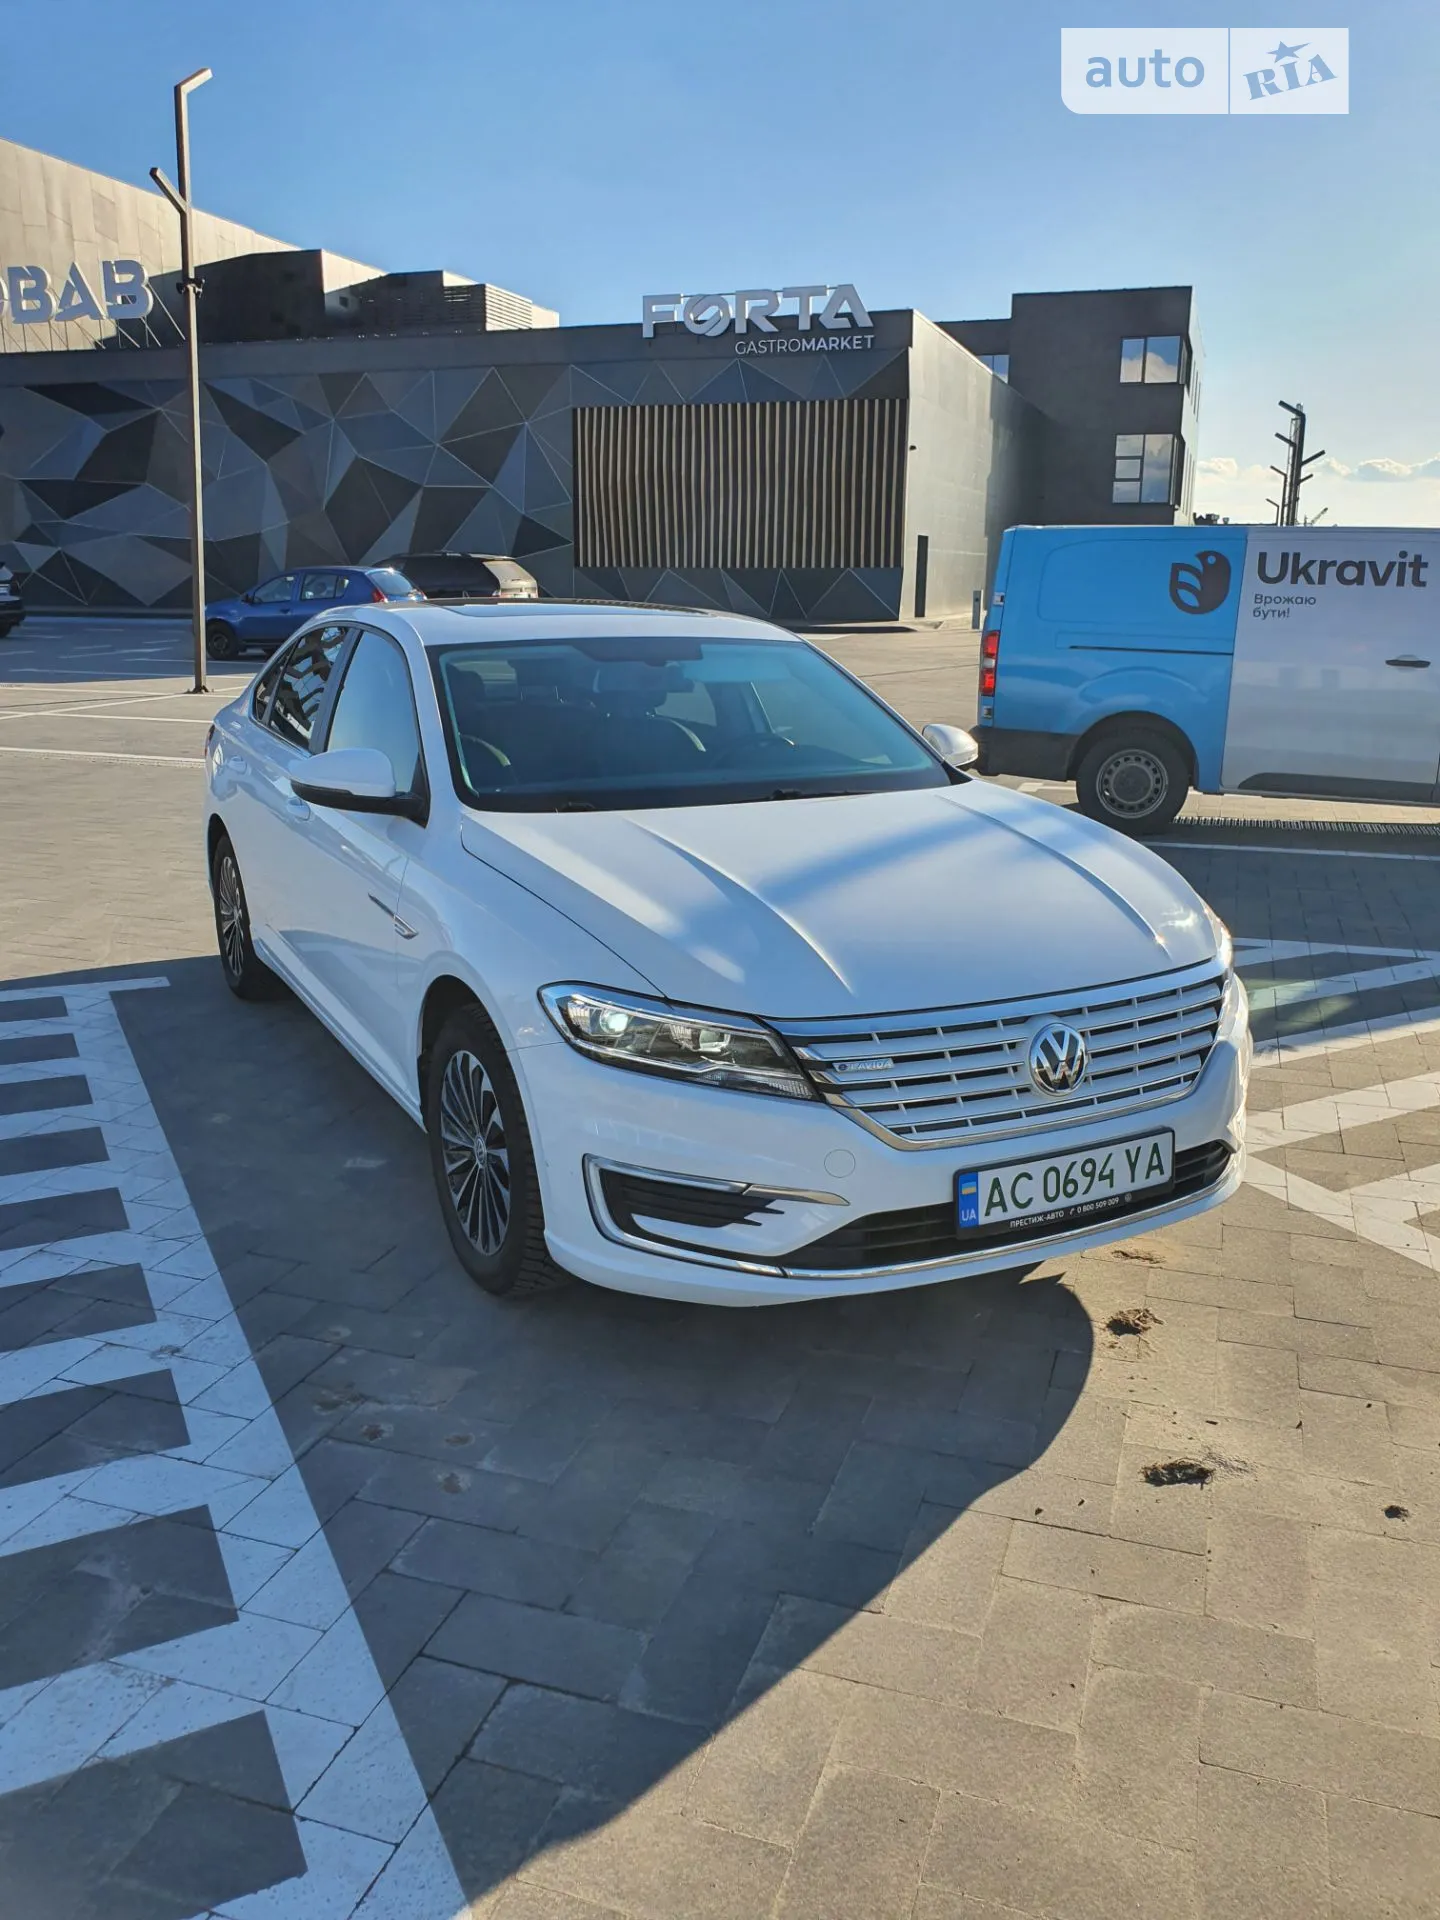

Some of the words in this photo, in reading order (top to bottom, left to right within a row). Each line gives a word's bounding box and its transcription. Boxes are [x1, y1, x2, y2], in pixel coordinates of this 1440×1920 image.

[0, 259, 154, 324] BAB
[642, 283, 874, 338] FORTA
[735, 335, 875, 355] GASTROMARKET
[1257, 550, 1429, 588] Ukravit
[1253, 593, 1317, 607] Врожаю
[1252, 607, 1291, 620] бути!
[984, 1172, 1034, 1217] AC
[1043, 1152, 1115, 1203] 0694
[1125, 1142, 1165, 1184] YA
[961, 1209, 977, 1222] UA
[1010, 1210, 1065, 1229] ПРЕСТИЖ-АВТО
